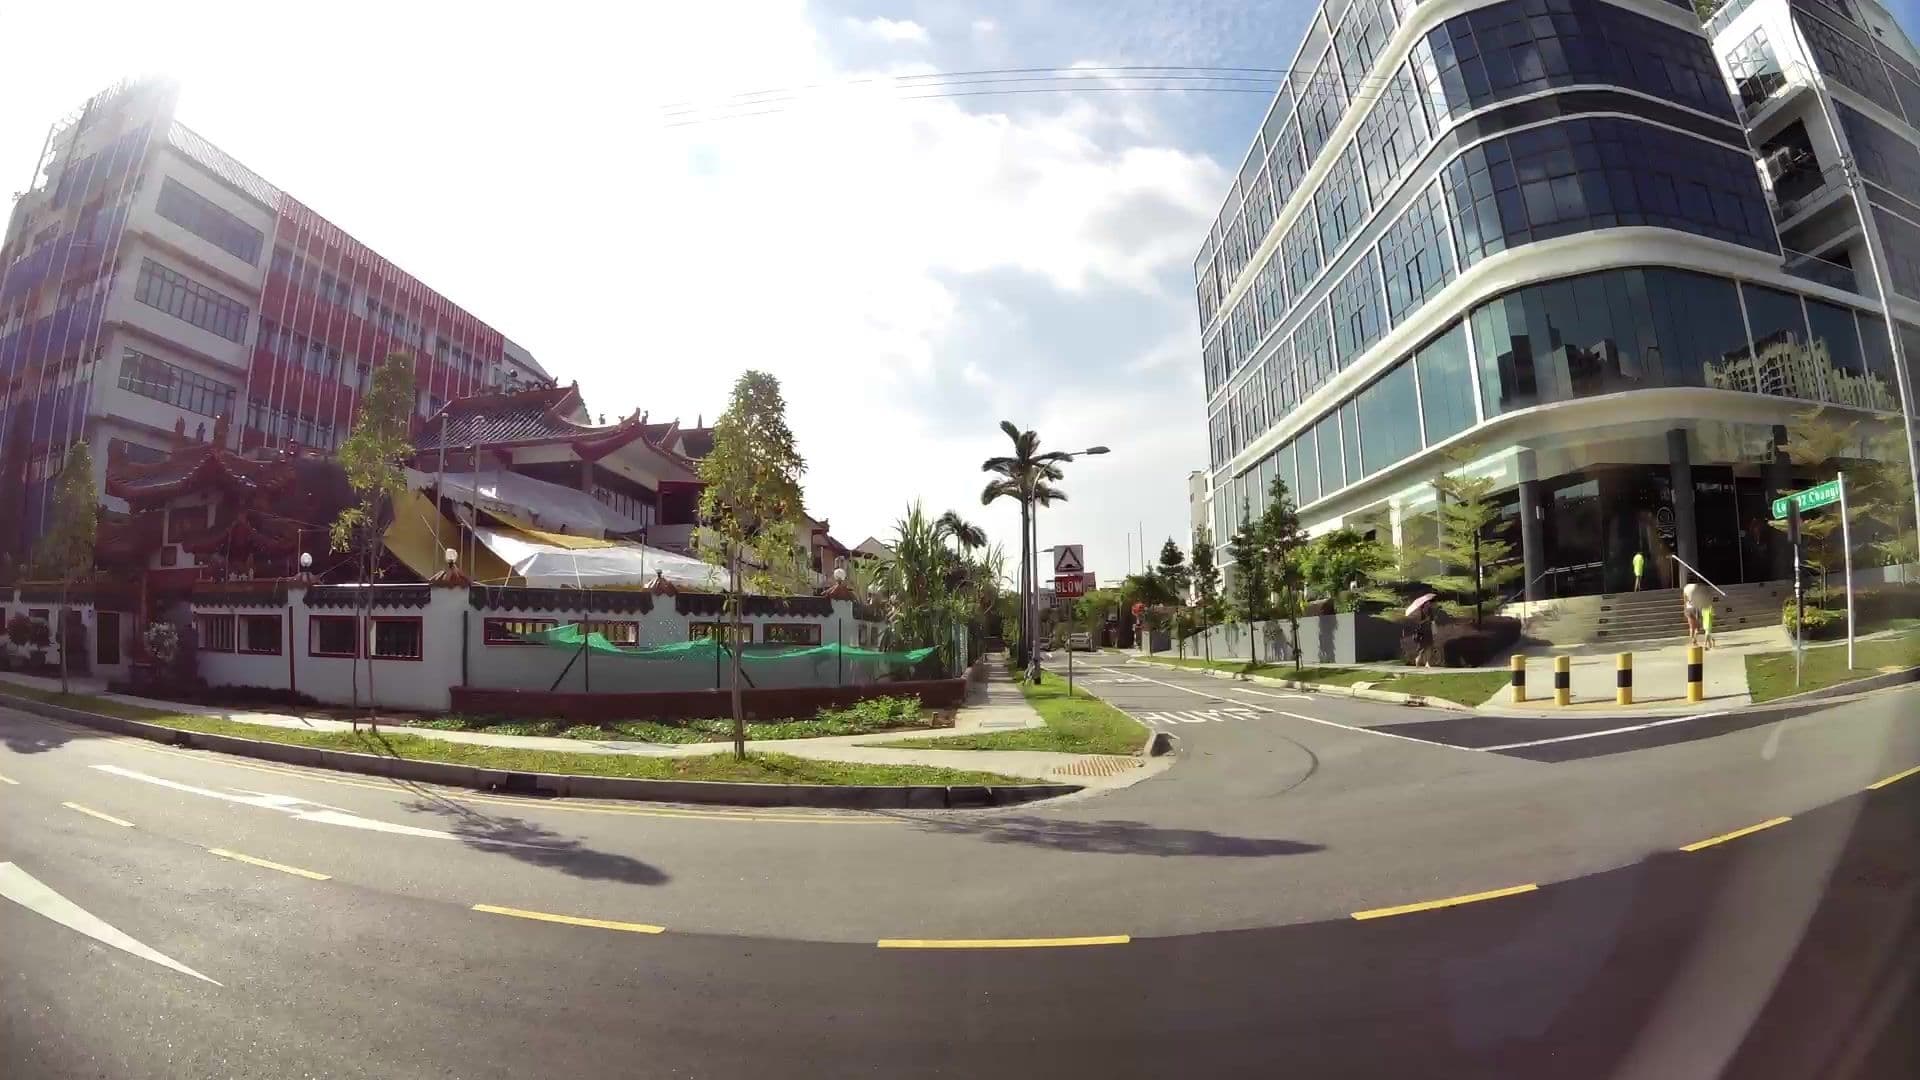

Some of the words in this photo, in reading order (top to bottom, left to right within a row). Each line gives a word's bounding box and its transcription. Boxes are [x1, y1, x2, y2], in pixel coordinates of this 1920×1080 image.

[1776, 501, 1788, 513] Lo
[1808, 486, 1839, 504] Changi
[1056, 580, 1083, 593] SLOW
[1142, 707, 1260, 724] HUMP
